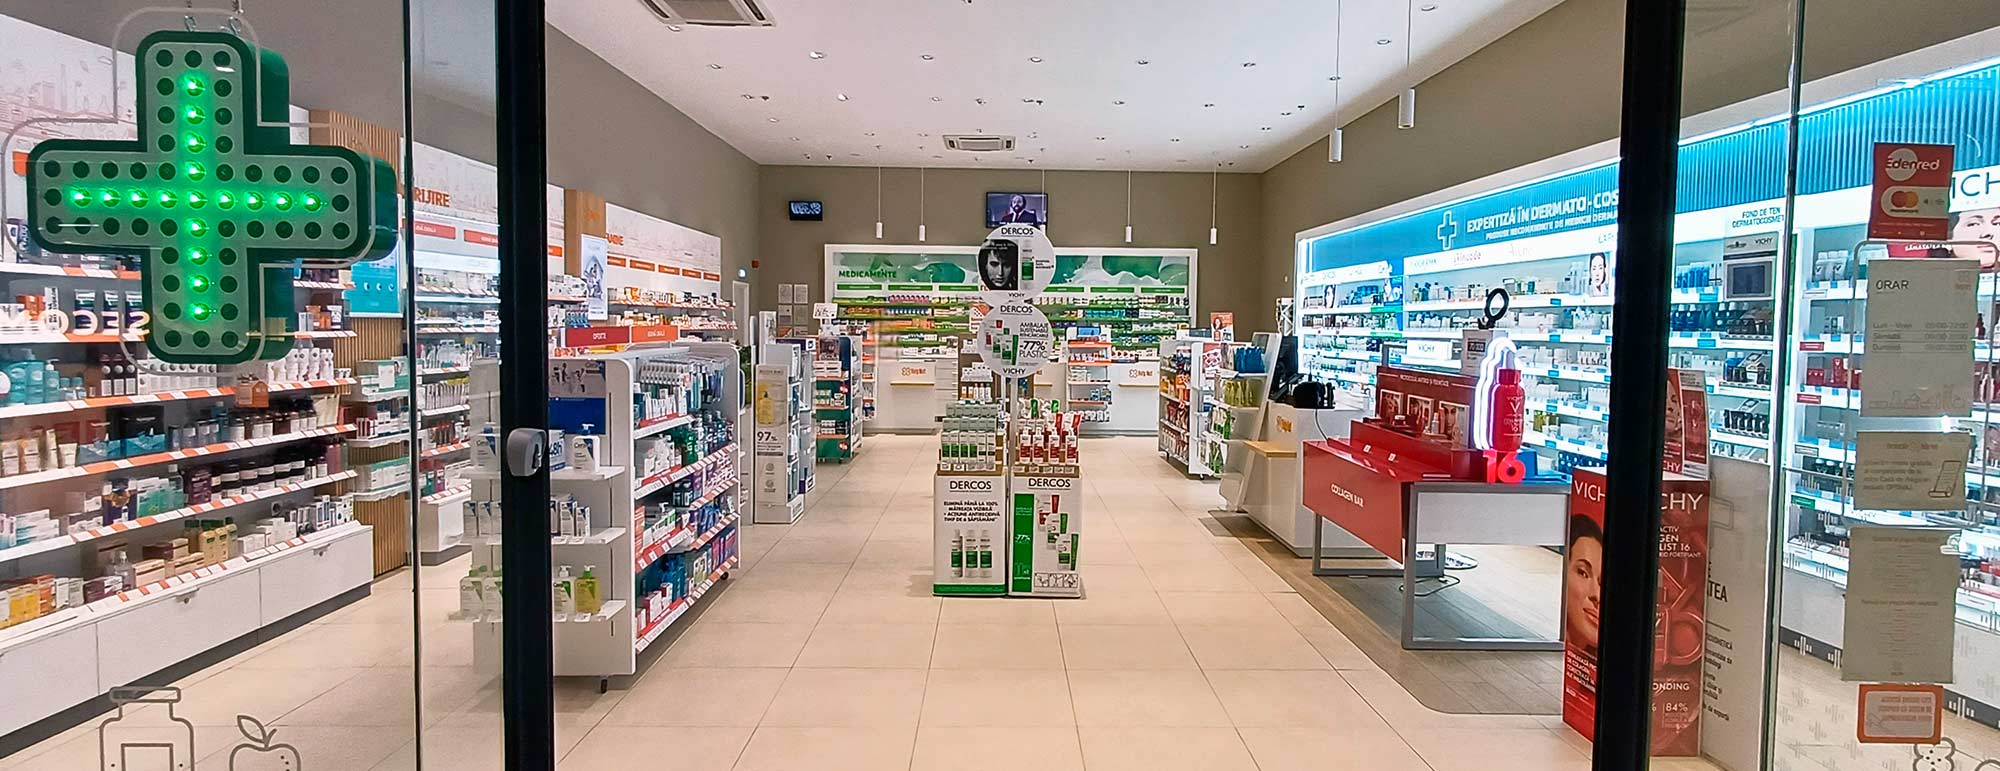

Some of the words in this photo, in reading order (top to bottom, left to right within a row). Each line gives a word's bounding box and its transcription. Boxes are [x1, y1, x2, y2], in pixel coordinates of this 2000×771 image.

[1886, 158, 1940, 171] Edenred
[1742, 210, 1758, 218] FOND
[1760, 208, 1767, 216] DE
[1769, 207, 1781, 215] TEN
[1467, 209, 1517, 232] EXPERTIZĂ
[1517, 207, 1530, 224] ÎN
[1001, 227, 1034, 236] DERCOS
[1755, 237, 1773, 245] VICHY
[839, 269, 897, 279] MEDICAMENTE
[1876, 279, 1909, 290] ORAR
[1000, 305, 1033, 314] DERCOS
[1019, 350, 1048, 359] PLASTIC
[1483, 450, 1526, 483] 16
[950, 481, 992, 490] DERCOS
[1028, 478, 1071, 488] DERCOS
[1331, 484, 1354, 503] COLLAGEN
[1681, 544, 1691, 552] 16
[1665, 703, 1688, 712] 84%
